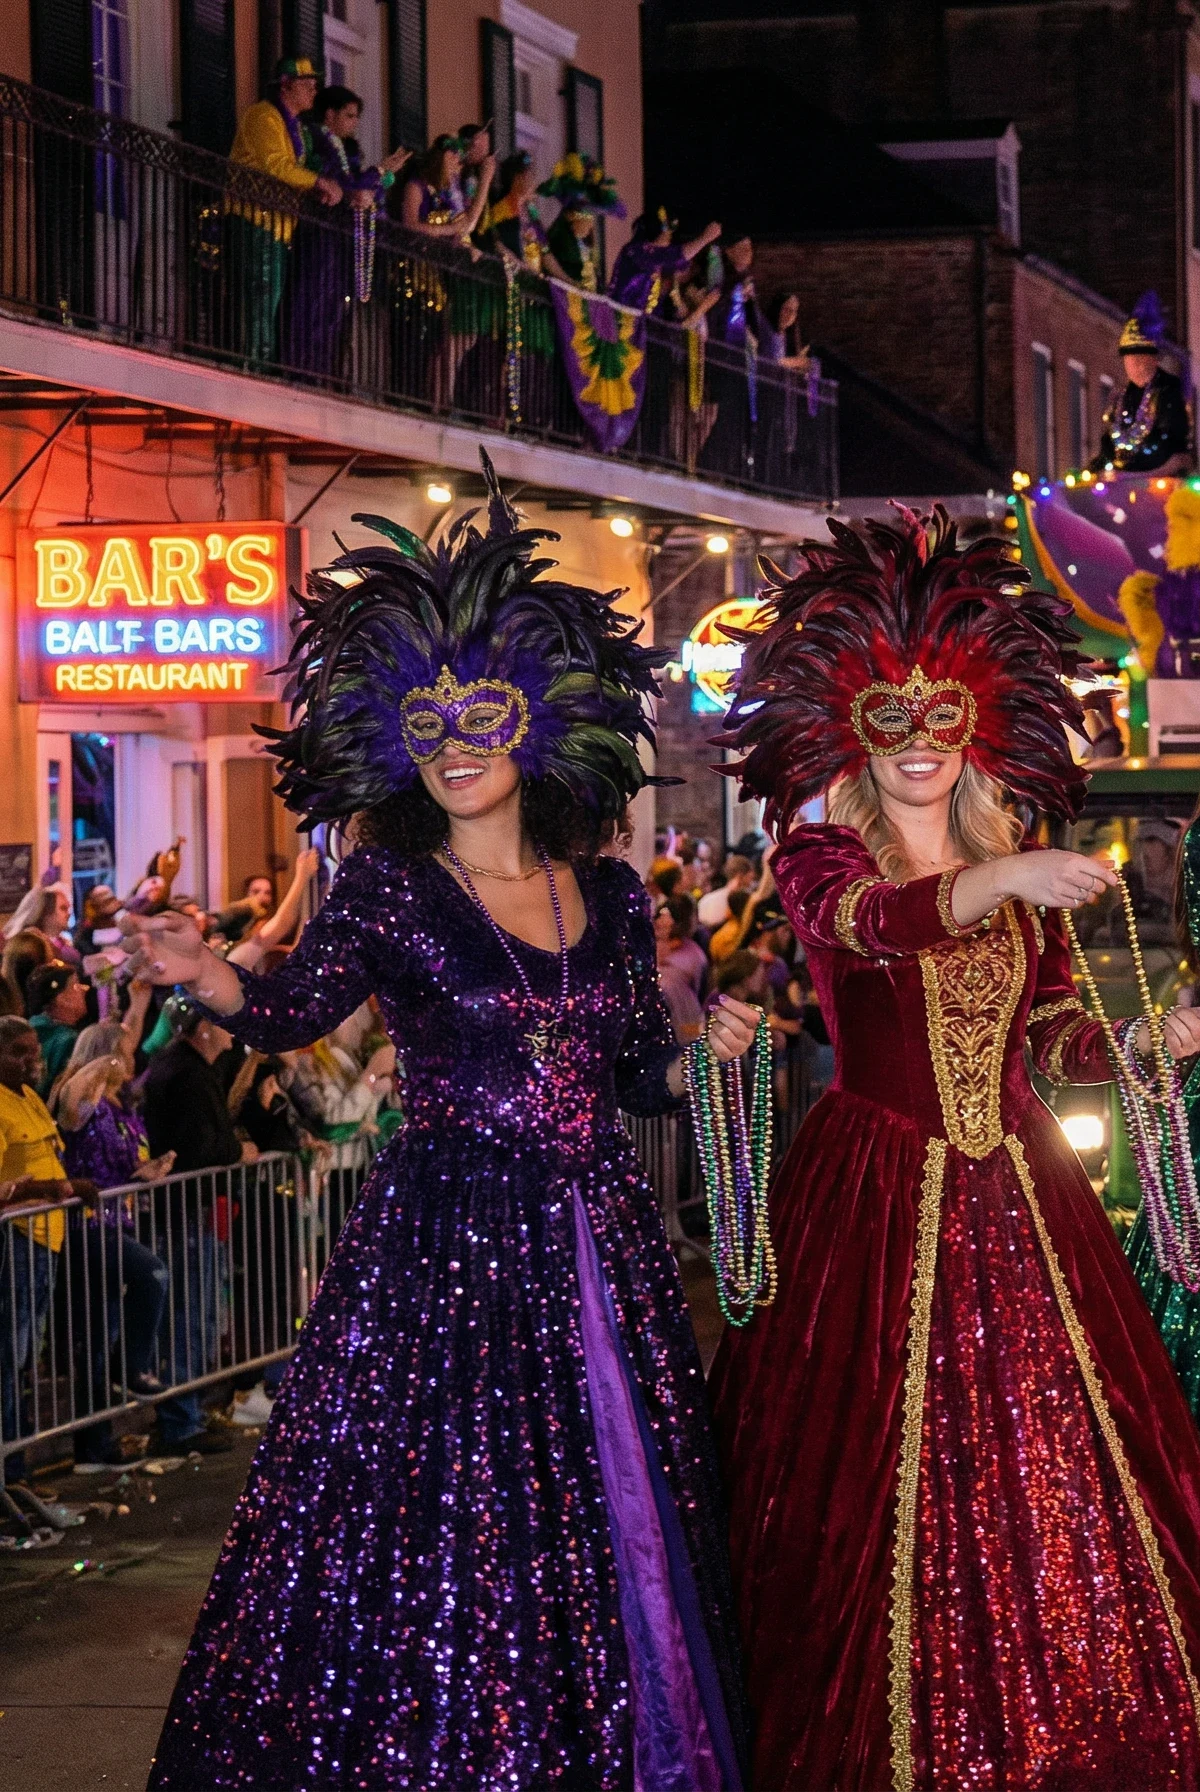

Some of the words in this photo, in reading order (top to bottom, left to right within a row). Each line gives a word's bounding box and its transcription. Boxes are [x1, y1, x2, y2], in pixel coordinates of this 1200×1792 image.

[34, 533, 276, 608] BAR'S
[154, 617, 262, 653] BARS
[56, 662, 249, 691] RESTAURANT
